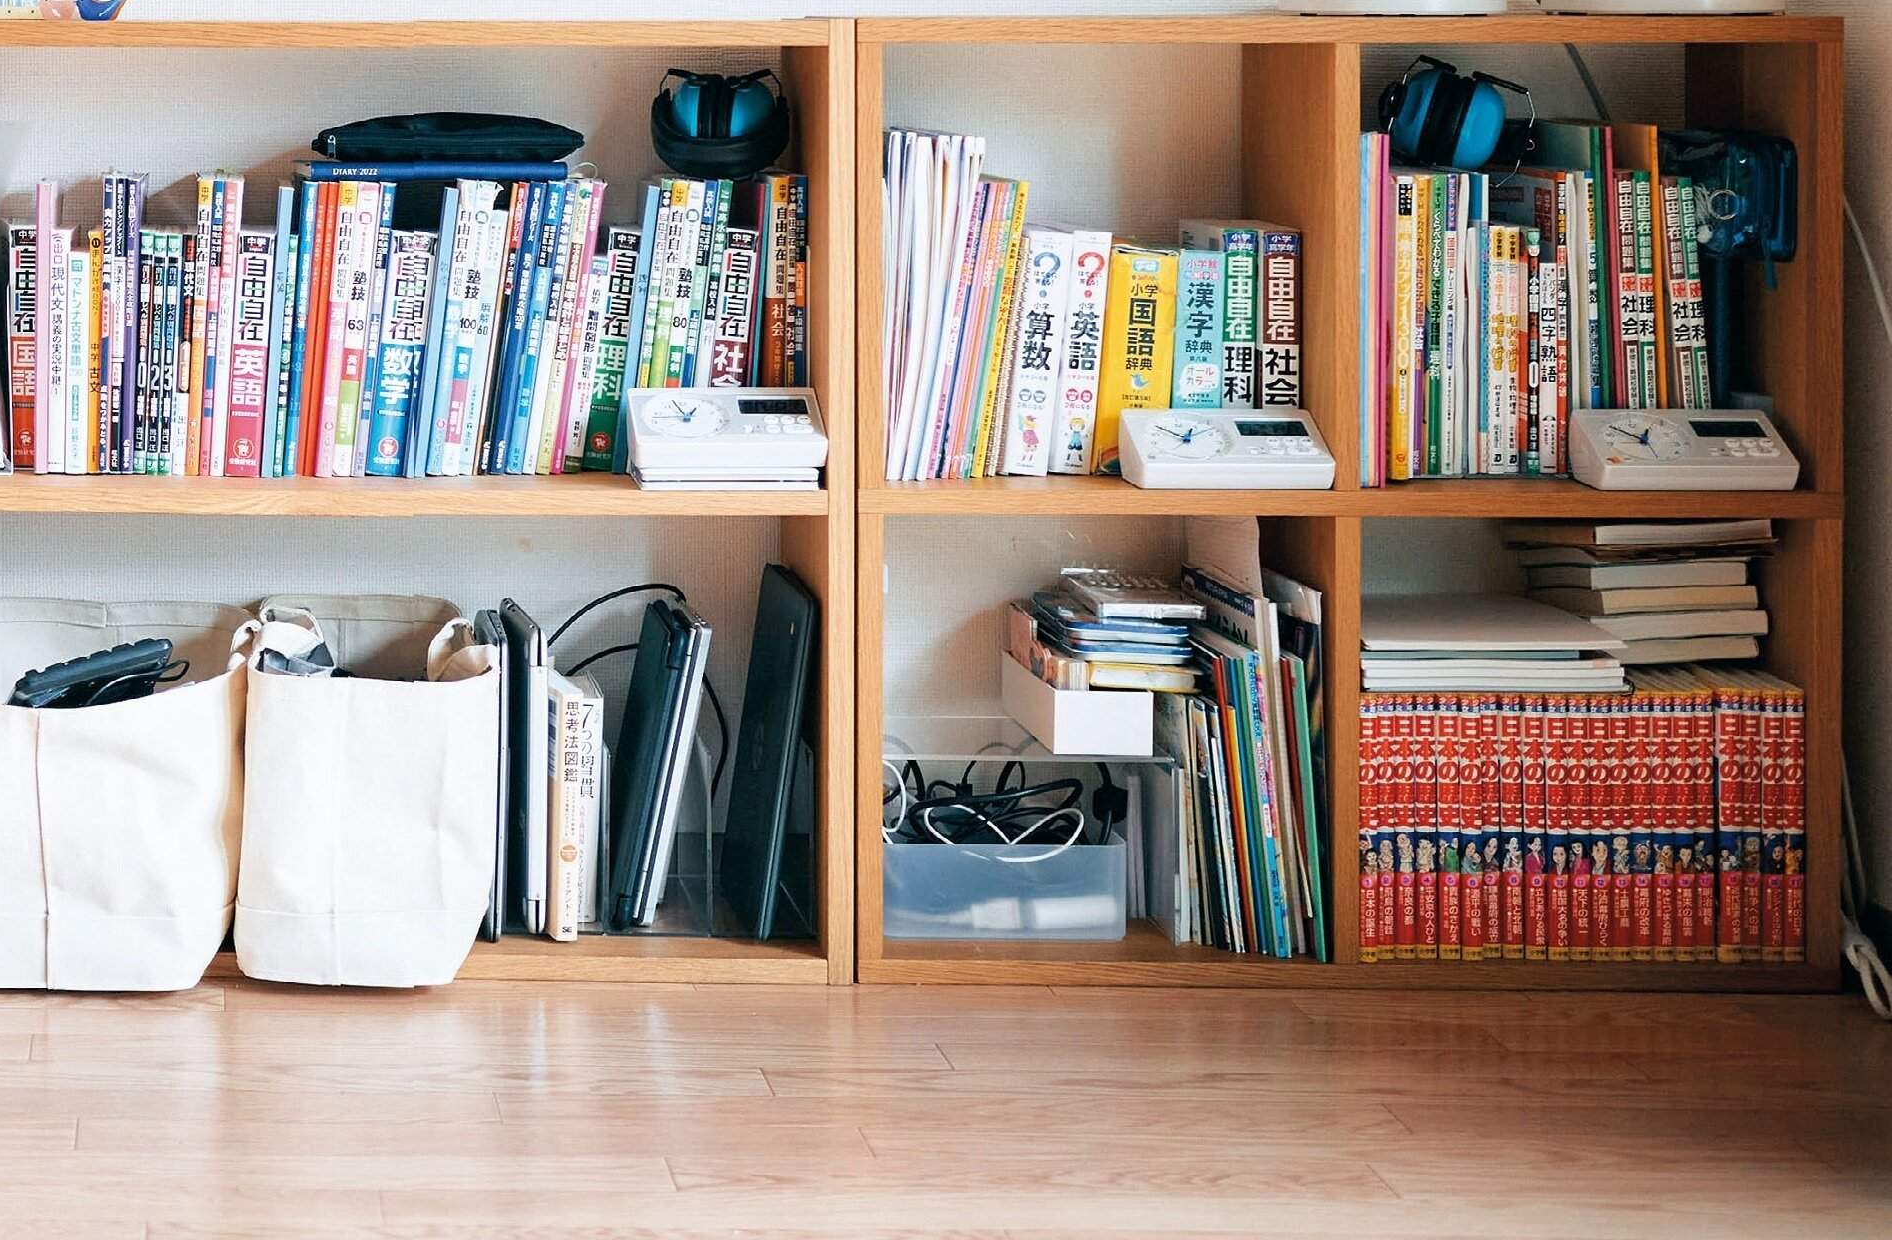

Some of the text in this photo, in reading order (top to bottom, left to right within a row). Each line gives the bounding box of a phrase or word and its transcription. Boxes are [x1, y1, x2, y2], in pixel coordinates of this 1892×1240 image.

[332, 167, 378, 176] DIARY 2022
[774, 206, 787, 262] 自由自在
[1618, 181, 1634, 233] 自由自在
[1636, 181, 1652, 234] 自由自在
[1664, 186, 1682, 240] 自由自在
[1681, 186, 1698, 240] 自由自在
[196, 210, 210, 262] 自由自在
[337, 211, 353, 265] 自由自在
[454, 210, 471, 263] 自由自在
[665, 209, 684, 264] 自由自在
[732, 233, 752, 244] 中学
[1231, 233, 1251, 242] 小学
[1271, 234, 1293, 243] 小学
[13, 248, 36, 333] 自由自在
[50, 267, 65, 311] 現代文
[183, 262, 195, 297] 現代文
[350, 270, 368, 301] 塾技
[463, 268, 481, 300] 塾技
[675, 267, 693, 299] 塾技
[719, 252, 751, 338] 自由自在
[775, 264, 784, 296] 問題集
[1131, 283, 1159, 297] 小学
[232, 237, 268, 405] 中学 自由自在 英語
[347, 319, 365, 331] 63
[459, 317, 477, 329] 100
[476, 324, 489, 336] 60
[593, 233, 638, 401] 中学 自由自在 理科
[672, 316, 688, 329] 80
[771, 304, 784, 337] 社会
[1126, 298, 1158, 356] 国語
[1187, 282, 1215, 338] 漢字
[1224, 257, 1253, 403] 自由自在 理科
[1265, 255, 1298, 407] 自由自在 社会
[1621, 296, 1638, 337] 社会
[1638, 296, 1655, 337] 理科
[1672, 302, 1691, 342] 社会
[1688, 302, 1707, 342] 理科
[785, 327, 796, 356] 社会
[1021, 310, 1055, 371] 算数
[1068, 310, 1100, 371] 英語
[1125, 358, 1153, 371] 辞典
[1185, 340, 1213, 354] 辞典
[1540, 307, 1557, 383] 四字熟語
[12, 340, 36, 397] 国語
[89, 367, 101, 393] 古文
[151, 364, 160, 391] 2
[163, 364, 173, 391] 3
[1186, 376, 1213, 385] カラー
[1187, 366, 1215, 376] オール
[564, 701, 580, 782] 思考法図鑑
[580, 703, 595, 799] 7つの習慣
[1359, 716, 1377, 830] 日本の歴史
[1377, 715, 1395, 828] 日本の歴史
[1395, 715, 1414, 828] 日本の歴史
[1438, 716, 1460, 828] 日本の歴史
[1460, 716, 1482, 831] 日本の歴史
[1481, 714, 1500, 827] 日本の歴史
[1501, 715, 1522, 827] 日本の歴史
[1524, 716, 1545, 828] 日本の歴史
[1547, 717, 1568, 830] 日本の歴史
[1568, 717, 1589, 830] 日本の歴史
[1589, 717, 1611, 830] 日本の歴史
[1610, 717, 1630, 830] 日本の歴史
[1630, 716, 1651, 829] 日本の歴史
[1651, 716, 1672, 829] 日本の歴史
[1673, 716, 1693, 829] 日本の歴史
[1693, 716, 1713, 828] 日本の歴史
[1415, 715, 1436, 944] 日本の歴史 平安京の人びと
[1578, 889, 1588, 934] 天下の統一
